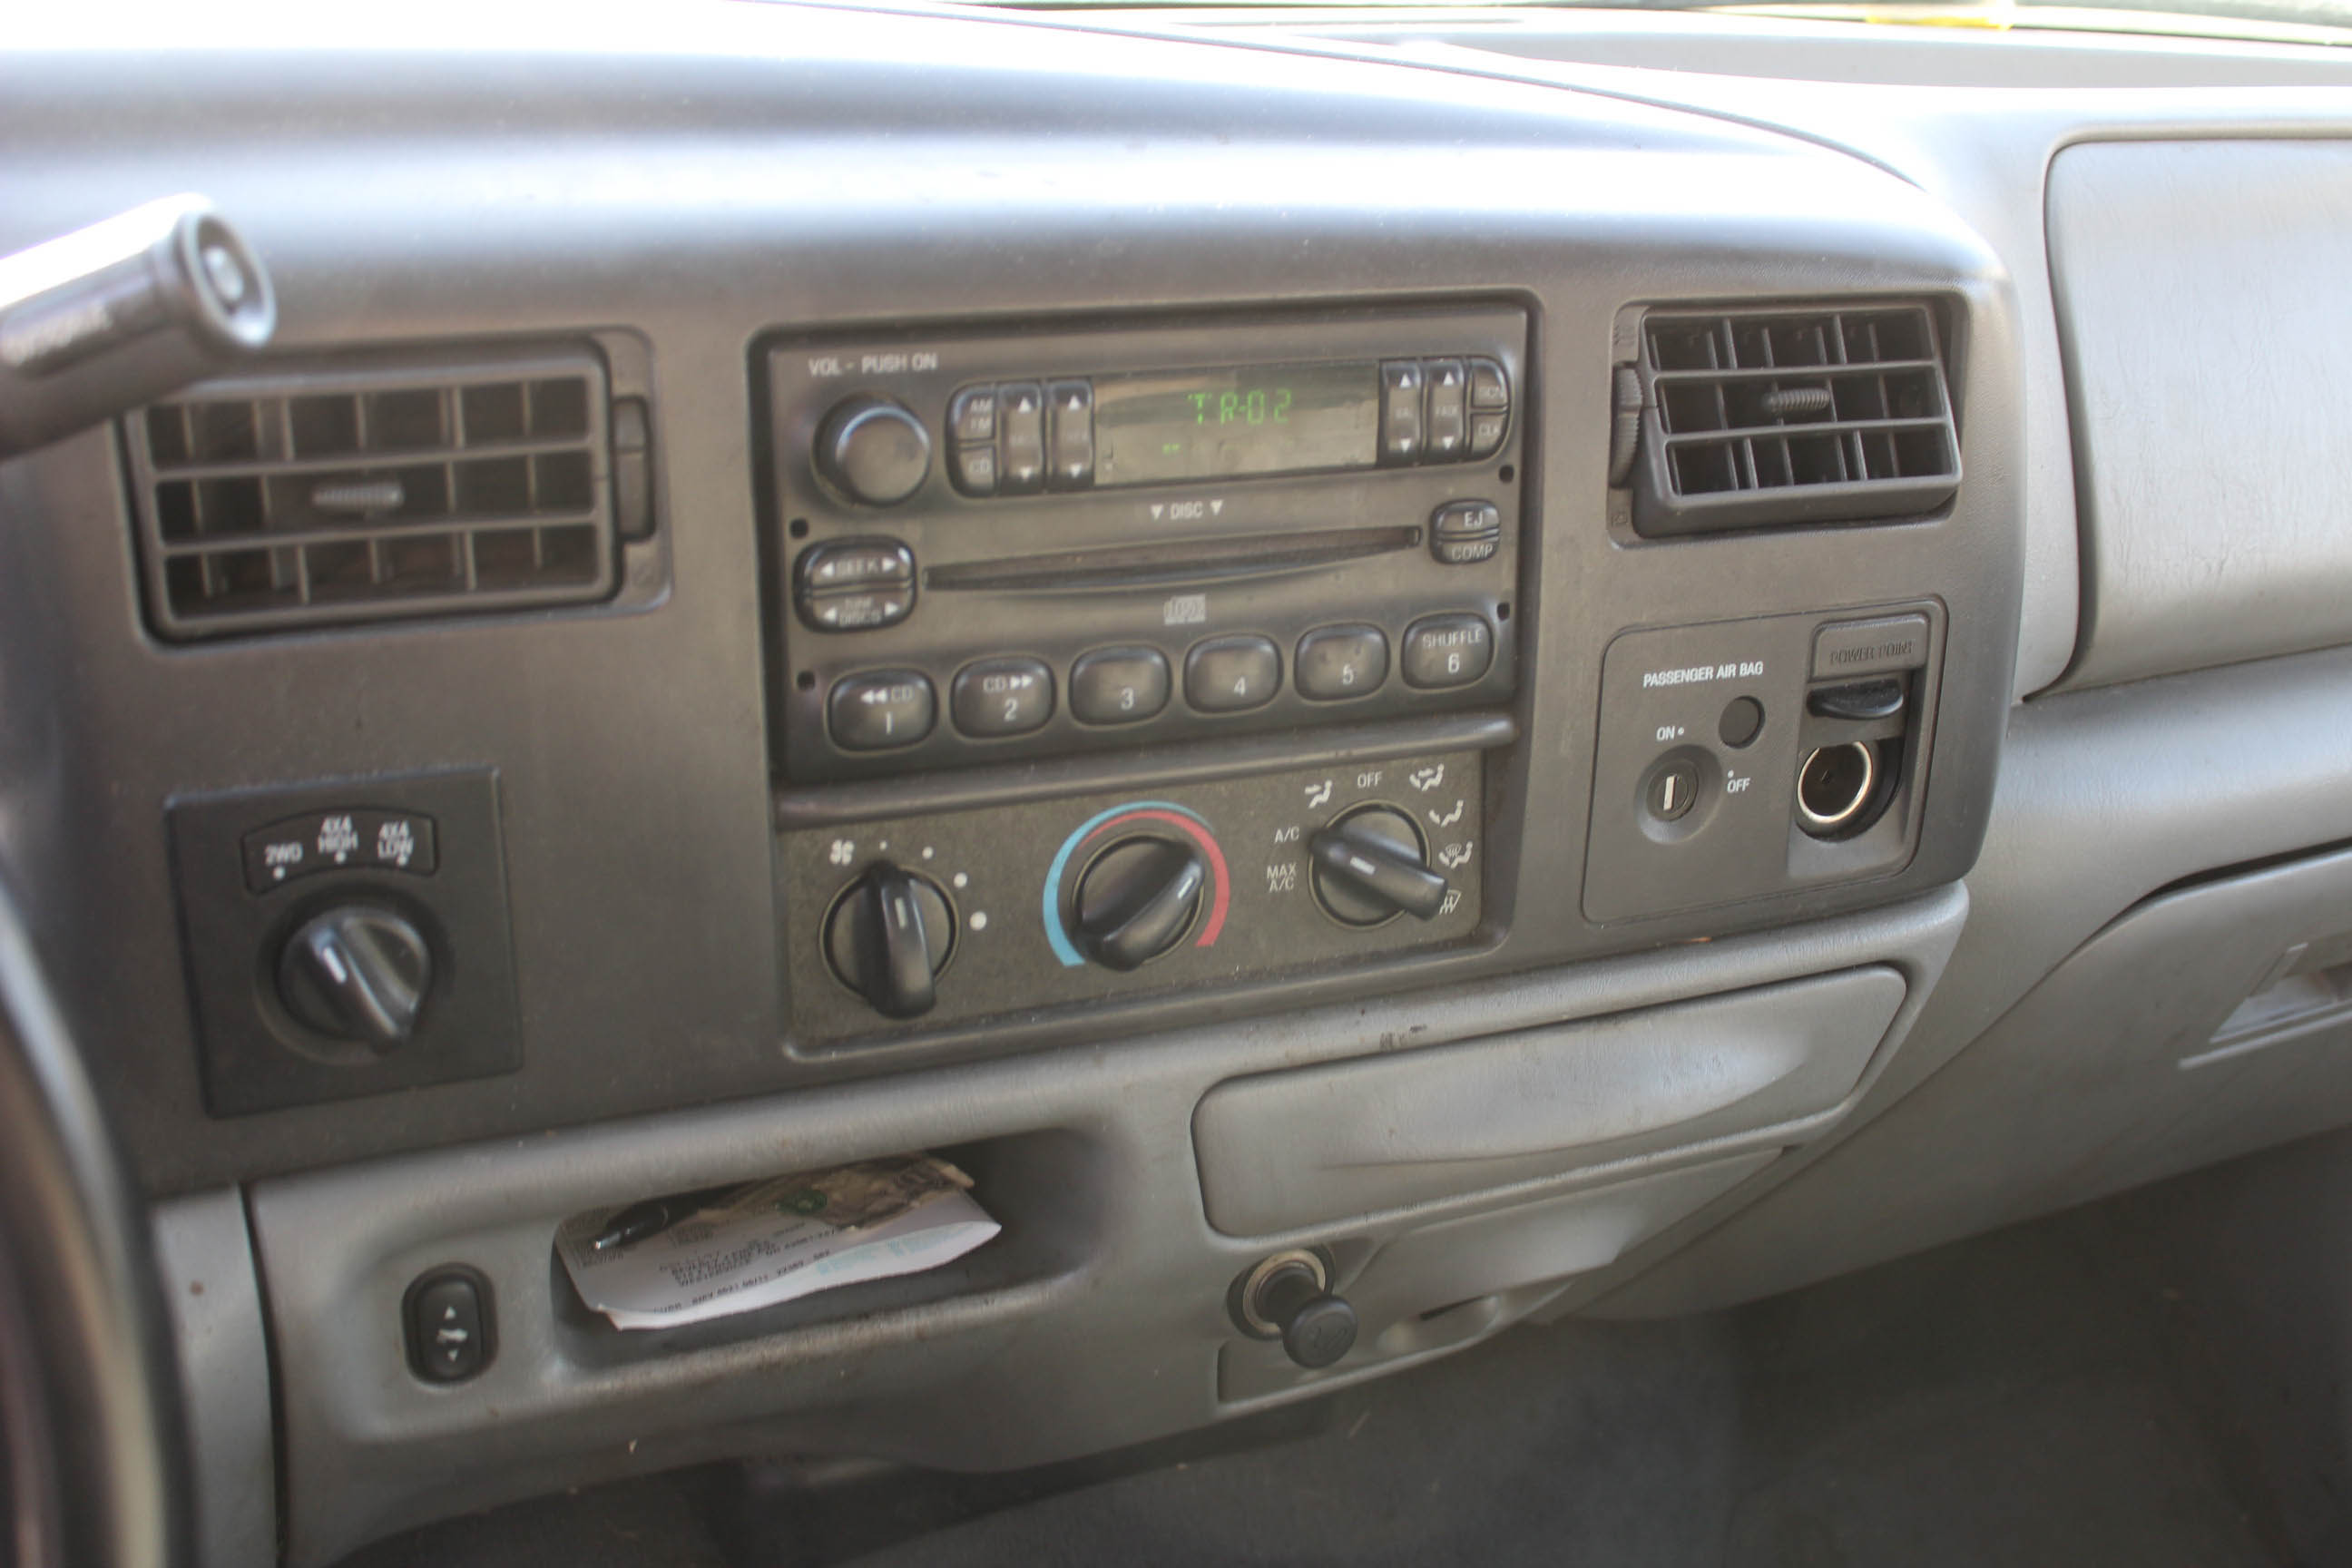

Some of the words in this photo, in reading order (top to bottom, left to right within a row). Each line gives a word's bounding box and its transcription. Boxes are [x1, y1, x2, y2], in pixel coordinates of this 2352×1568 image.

[808, 358, 842, 377] VOL
[861, 355, 906, 374] PUSH
[911, 353, 936, 371] ON
[970, 397, 993, 412] AM
[970, 416, 993, 429] FM
[968, 458, 991, 473] CD
[1170, 501, 1203, 518] DISC
[1465, 511, 1484, 527] EJ
[1452, 545, 1494, 561] COMP
[835, 558, 879, 575] SEEK
[1422, 628, 1483, 649] SHUFFLE
[1829, 646, 1875, 664] POWER
[1879, 640, 1916, 659] POINT
[1447, 653, 1460, 673] 6
[1342, 665, 1354, 684] 5
[1643, 665, 1714, 688] PASSENGER
[1716, 663, 1737, 679] AIR
[1740, 662, 1763, 677] BAG
[984, 677, 1005, 692] CD
[1233, 676, 1248, 696] 4
[891, 687, 914, 702] CD
[1120, 688, 1134, 710] 3
[1004, 699, 1018, 721] 2
[885, 712, 893, 734] 1
[1656, 726, 1675, 740] ON
[1357, 771, 1383, 789] OFF
[1727, 778, 1751, 793] OFF
[1274, 827, 1299, 843] A/C
[265, 842, 303, 866] 2WD
[377, 837, 414, 859] LOW
[1267, 864, 1297, 879] MAX
[1269, 877, 1295, 893] A/C
